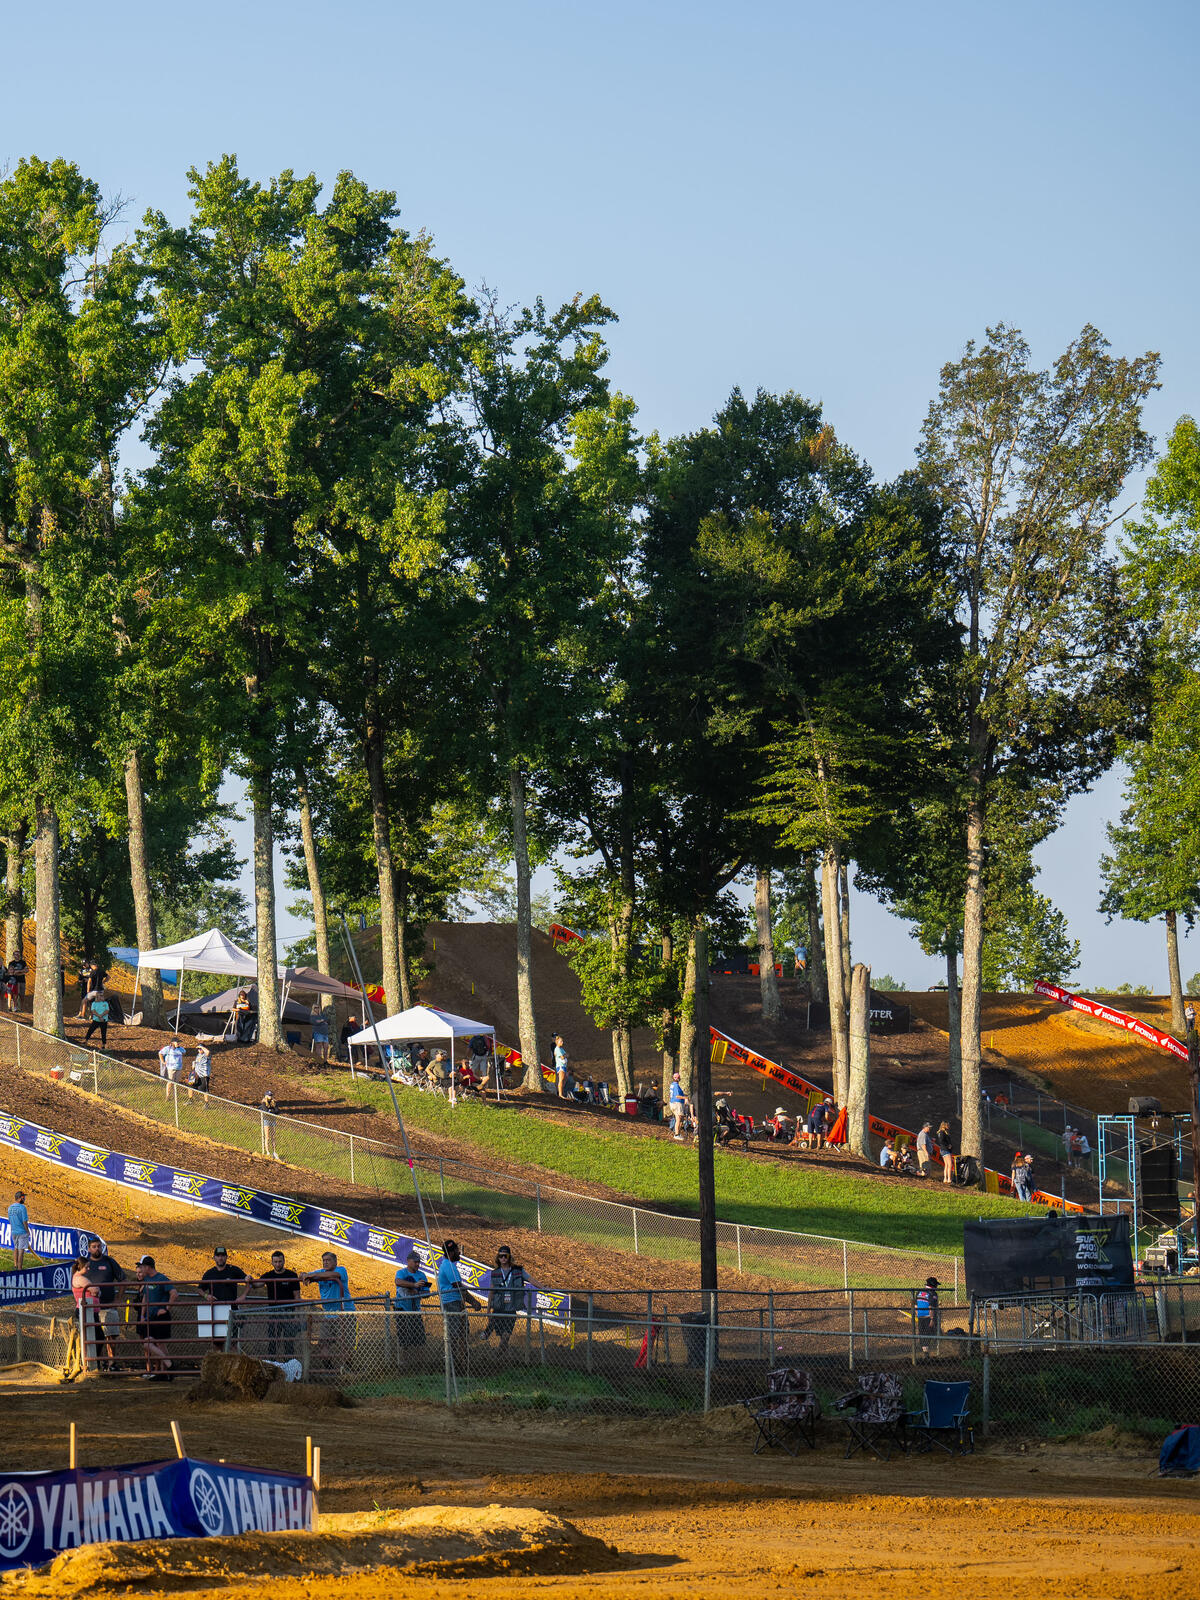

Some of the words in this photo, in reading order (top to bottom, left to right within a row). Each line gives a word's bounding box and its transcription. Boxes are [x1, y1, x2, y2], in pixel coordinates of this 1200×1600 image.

[1037, 985, 1060, 1000] HONDA
[1068, 998, 1093, 1013] HONDA
[1102, 1011, 1126, 1027] HONDA
[1134, 1024, 1159, 1043] HONDA
[769, 1068, 785, 1080] KTM
[31, 1228, 73, 1255] YAMAHA
[36, 1474, 174, 1550] YAMAHA
[219, 1475, 314, 1536] YAMAHA
